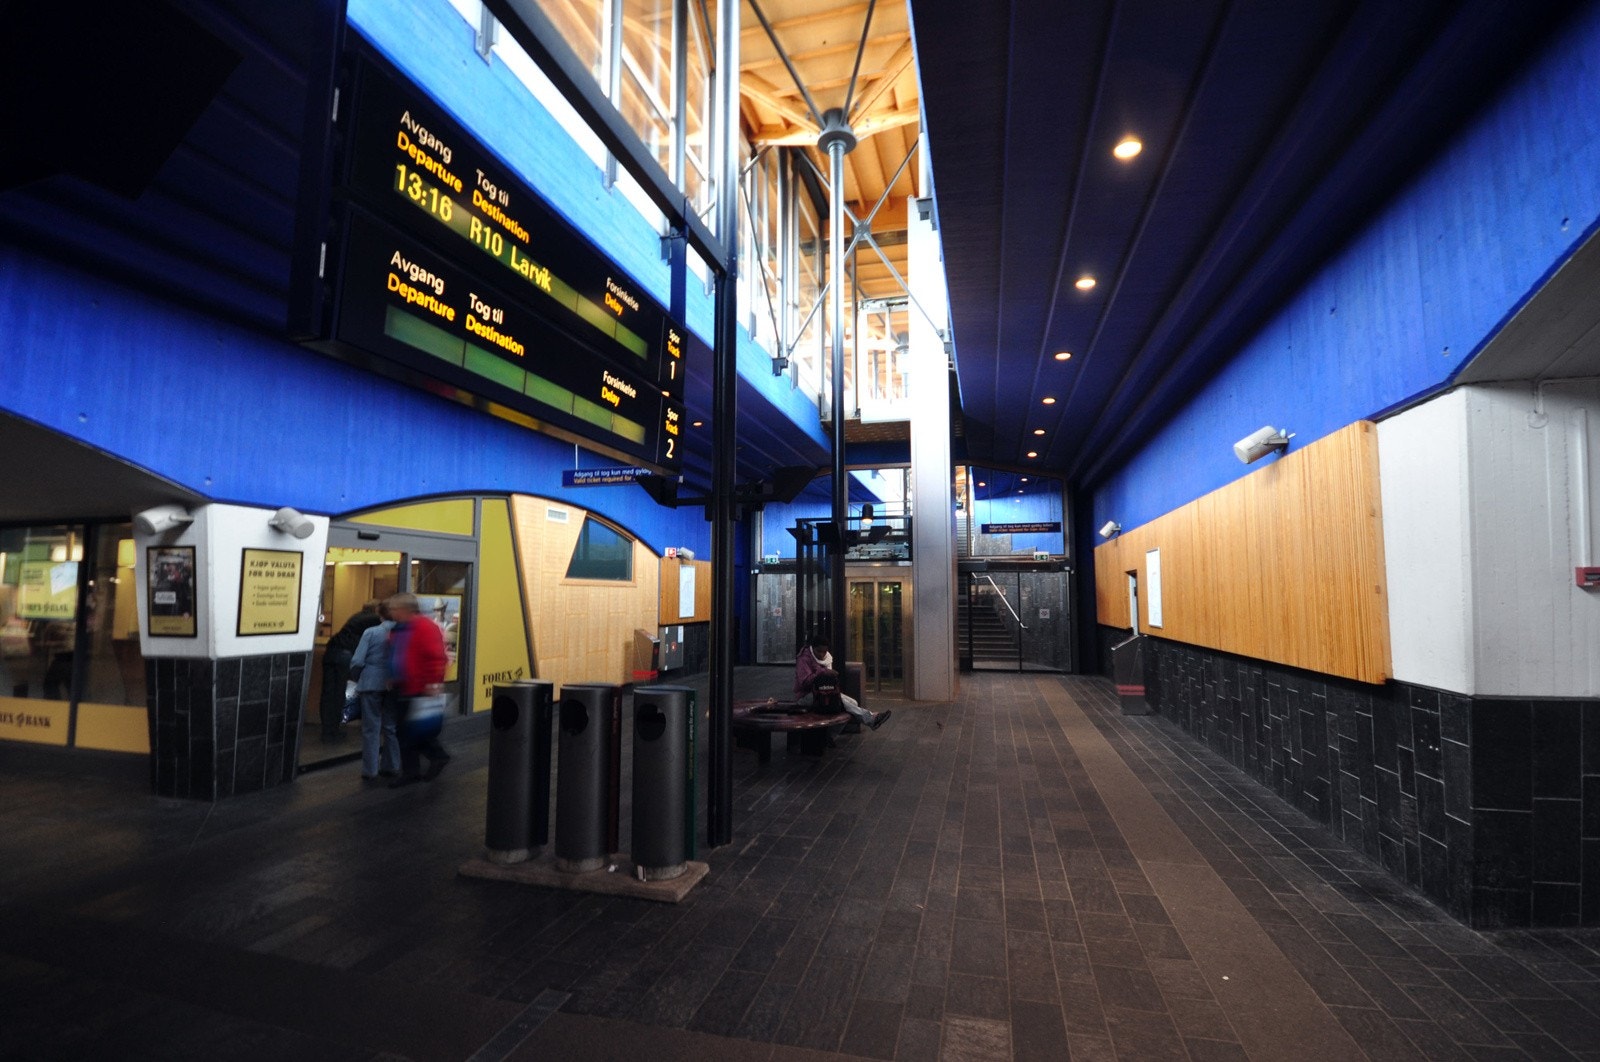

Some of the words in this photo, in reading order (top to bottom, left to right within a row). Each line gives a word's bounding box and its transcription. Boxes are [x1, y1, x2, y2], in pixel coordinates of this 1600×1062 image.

[400, 110, 452, 164] Avgang
[397, 131, 463, 193] Departure
[475, 168, 497, 200] Tog
[498, 189, 509, 207] til
[396, 164, 452, 222] 13:16
[470, 215, 503, 257] R10
[510, 245, 552, 292] Larvik
[472, 189, 530, 243] Destination
[390, 250, 445, 295] Avgang
[387, 272, 456, 322] Departure
[469, 292, 491, 321] Tog
[492, 308, 504, 325] til
[604, 292, 624, 316] Delay
[606, 276, 639, 312] Forsinkelse
[465, 313, 525, 357] Destination
[602, 370, 637, 399] Forsinkelse
[670, 360, 676, 380] 1
[601, 386, 620, 407] Delay
[665, 438, 675, 459] 2
[277, 570, 295, 578] DRAR
[483, 670, 512, 685] FOREX
